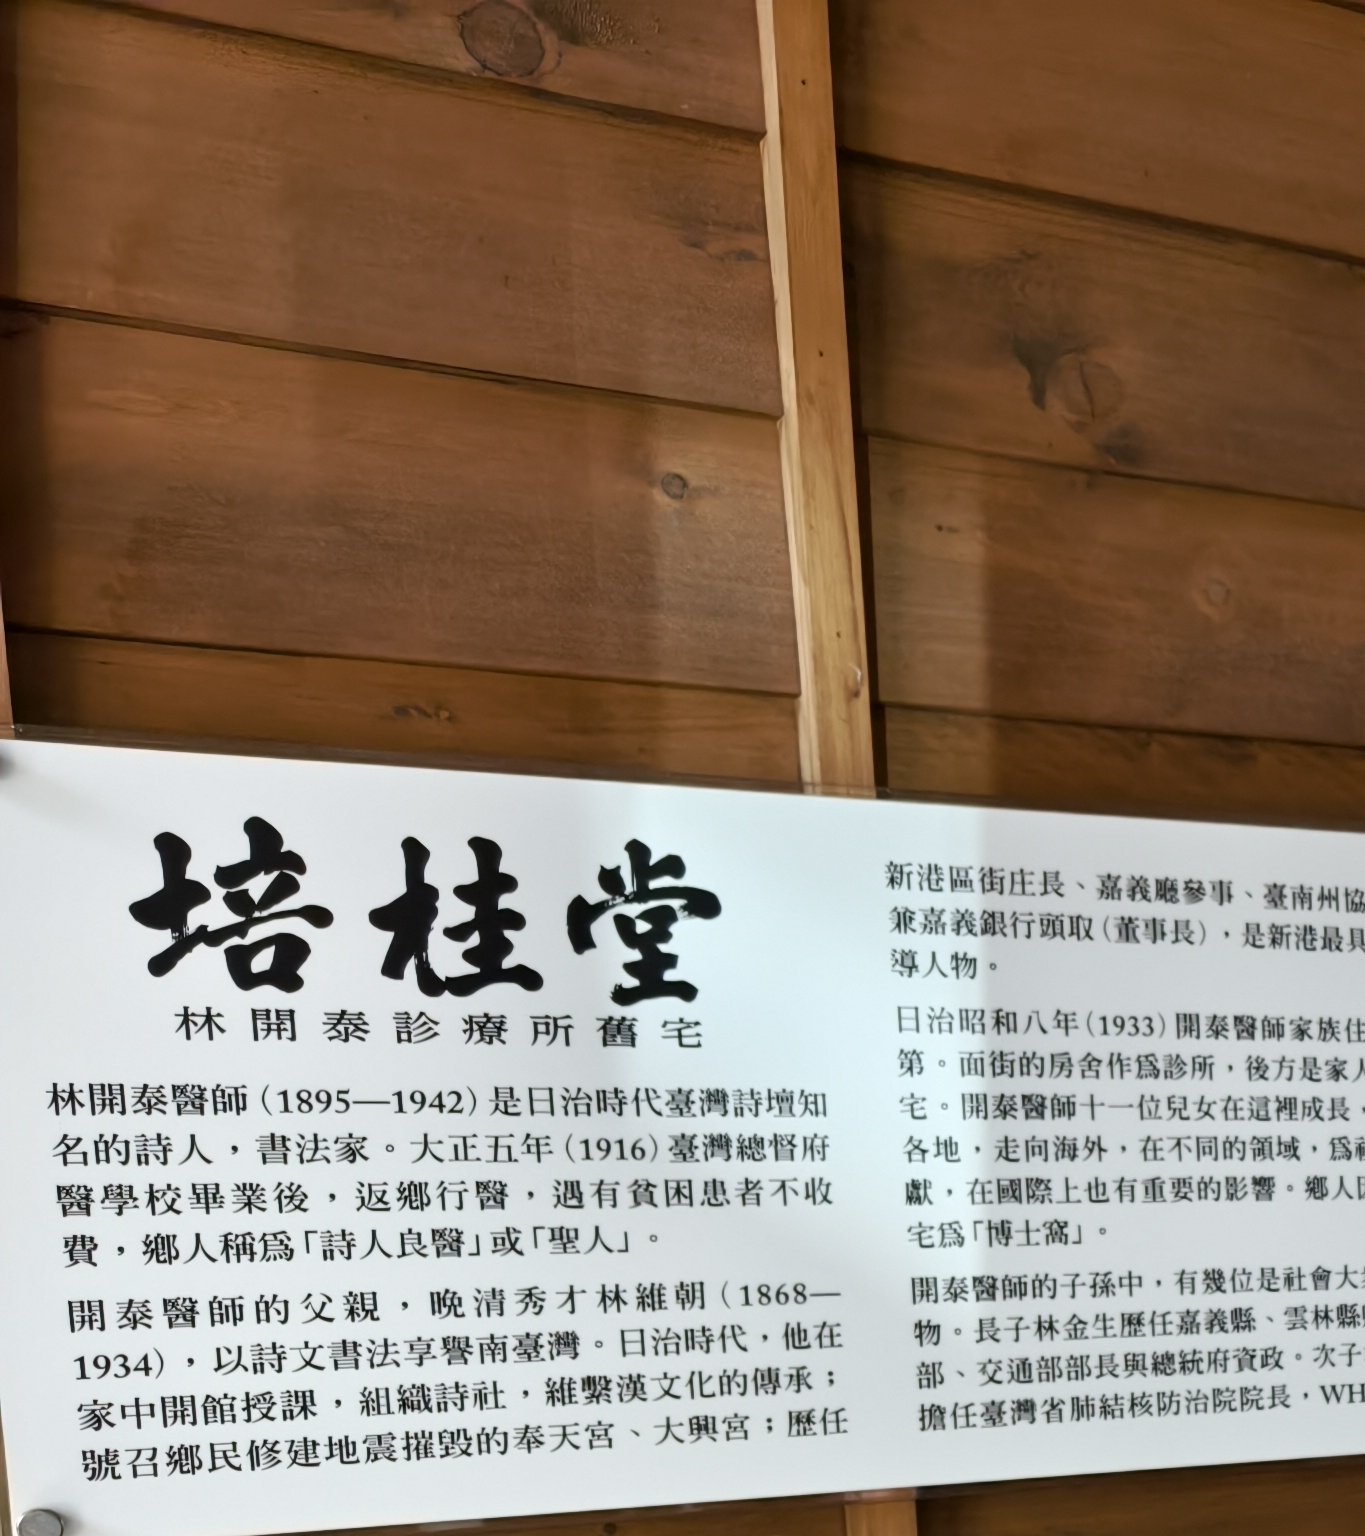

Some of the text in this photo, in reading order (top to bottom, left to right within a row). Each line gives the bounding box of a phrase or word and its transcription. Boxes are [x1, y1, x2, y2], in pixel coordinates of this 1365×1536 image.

[129, 816, 722, 1005] 培桂堂
[891, 949, 997, 979] 導人物。
[174, 1006, 702, 1048] 林開泰診療所舊宅
